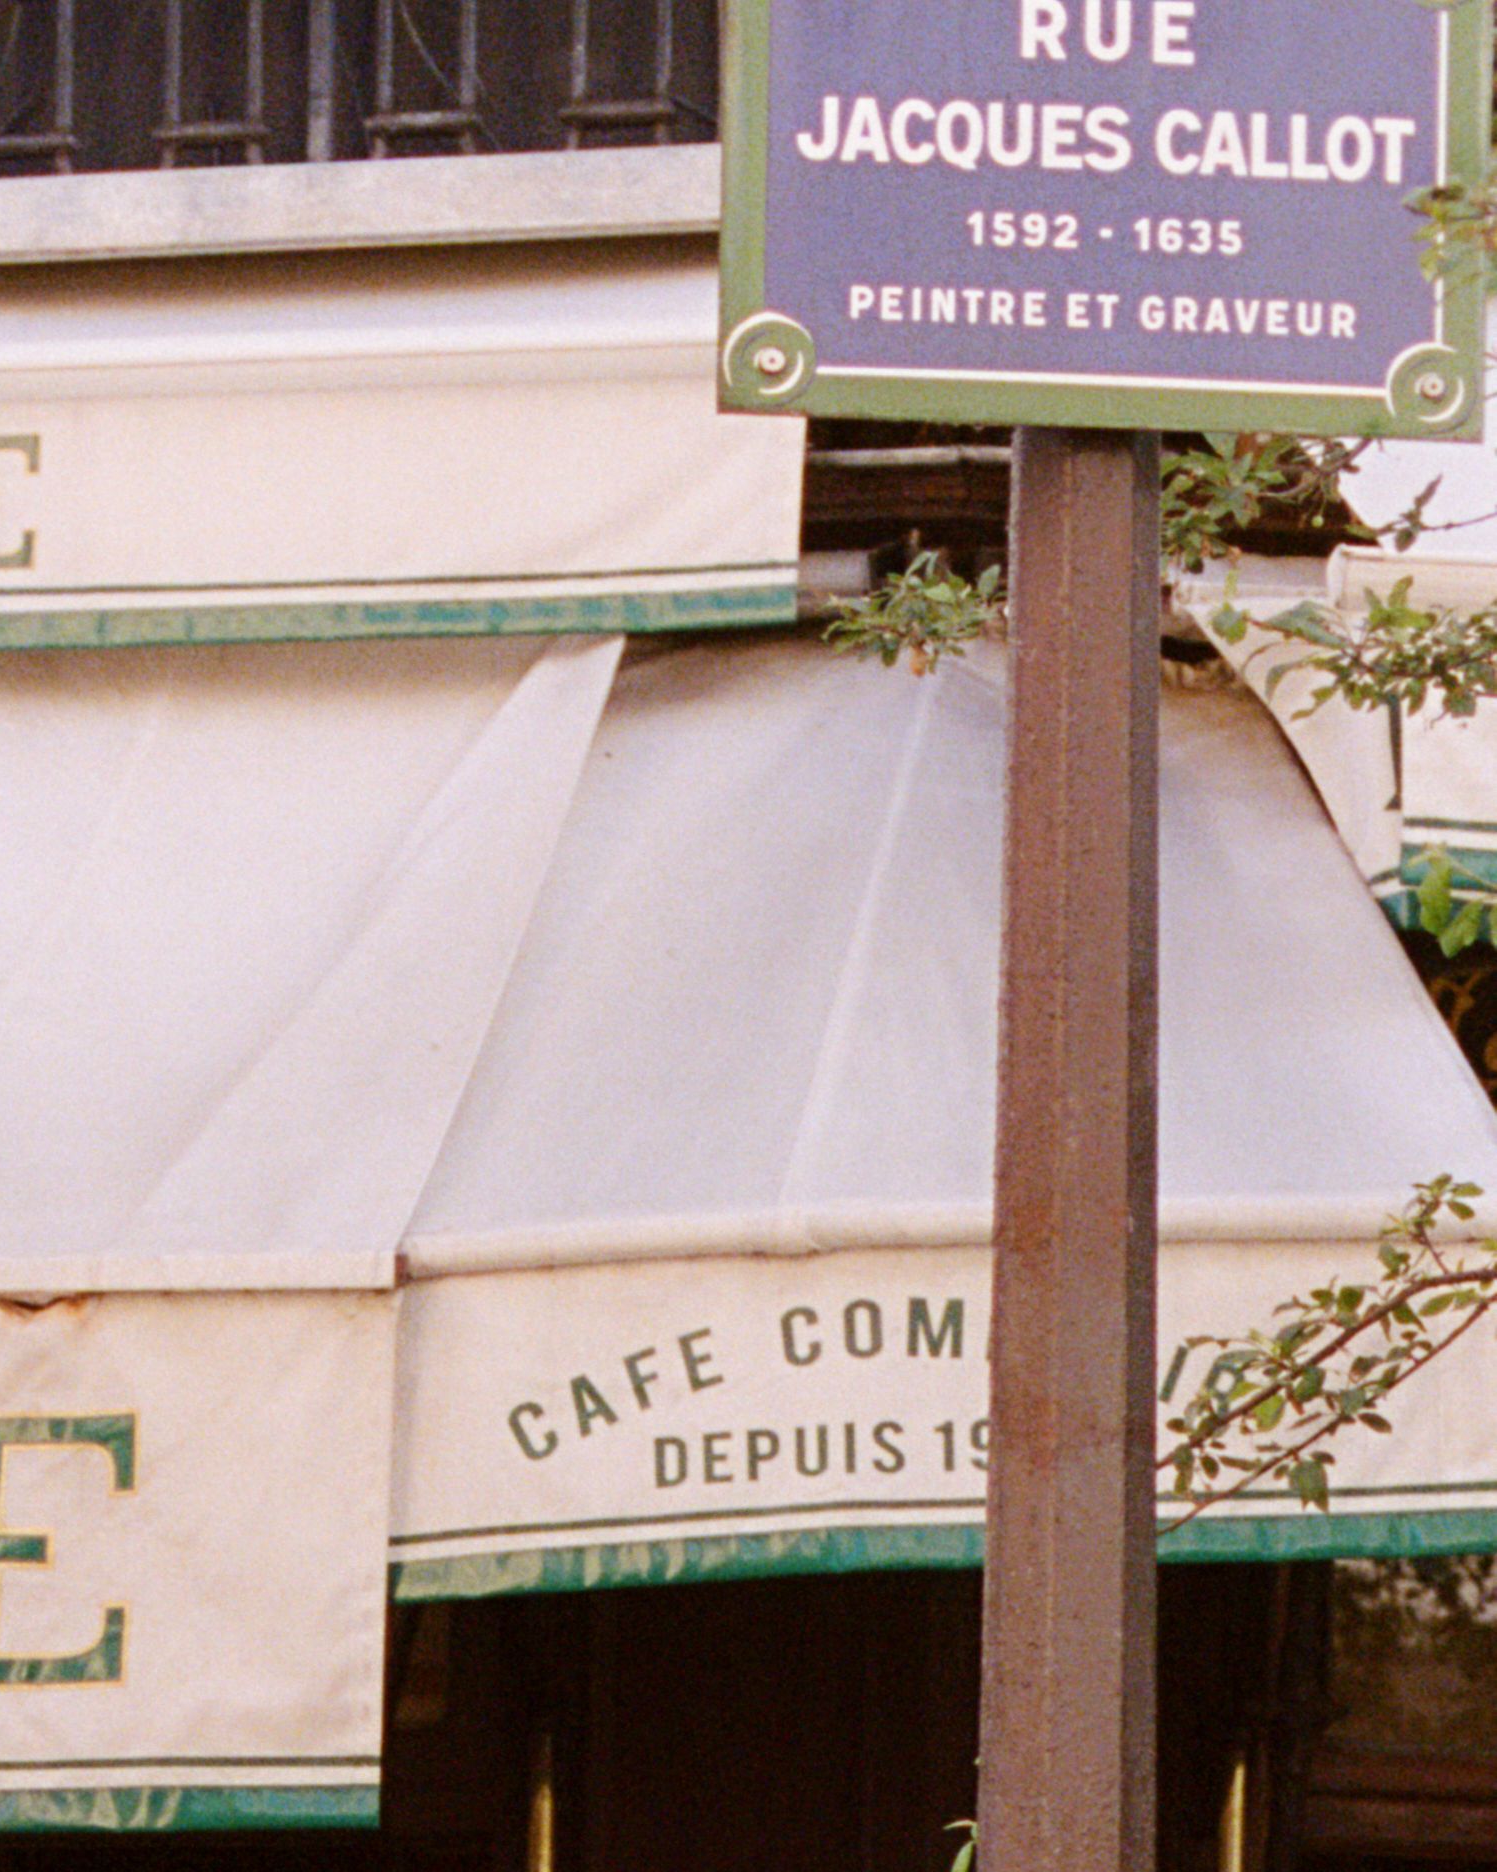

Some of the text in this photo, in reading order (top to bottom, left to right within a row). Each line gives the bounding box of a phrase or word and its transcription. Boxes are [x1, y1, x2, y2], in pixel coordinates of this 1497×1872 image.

[1019, 0, 1196, 66] RUE
[796, 95, 1416, 183] JACQUES CALLOT
[967, 210, 1079, 250] 1592
[1133, 217, 1243, 256] 1635
[849, 285, 1358, 339] PEINTRE ET GRAVEUR
[507, 1326, 725, 1462] CAFE
[653, 1420, 906, 1490] DEPUIS
